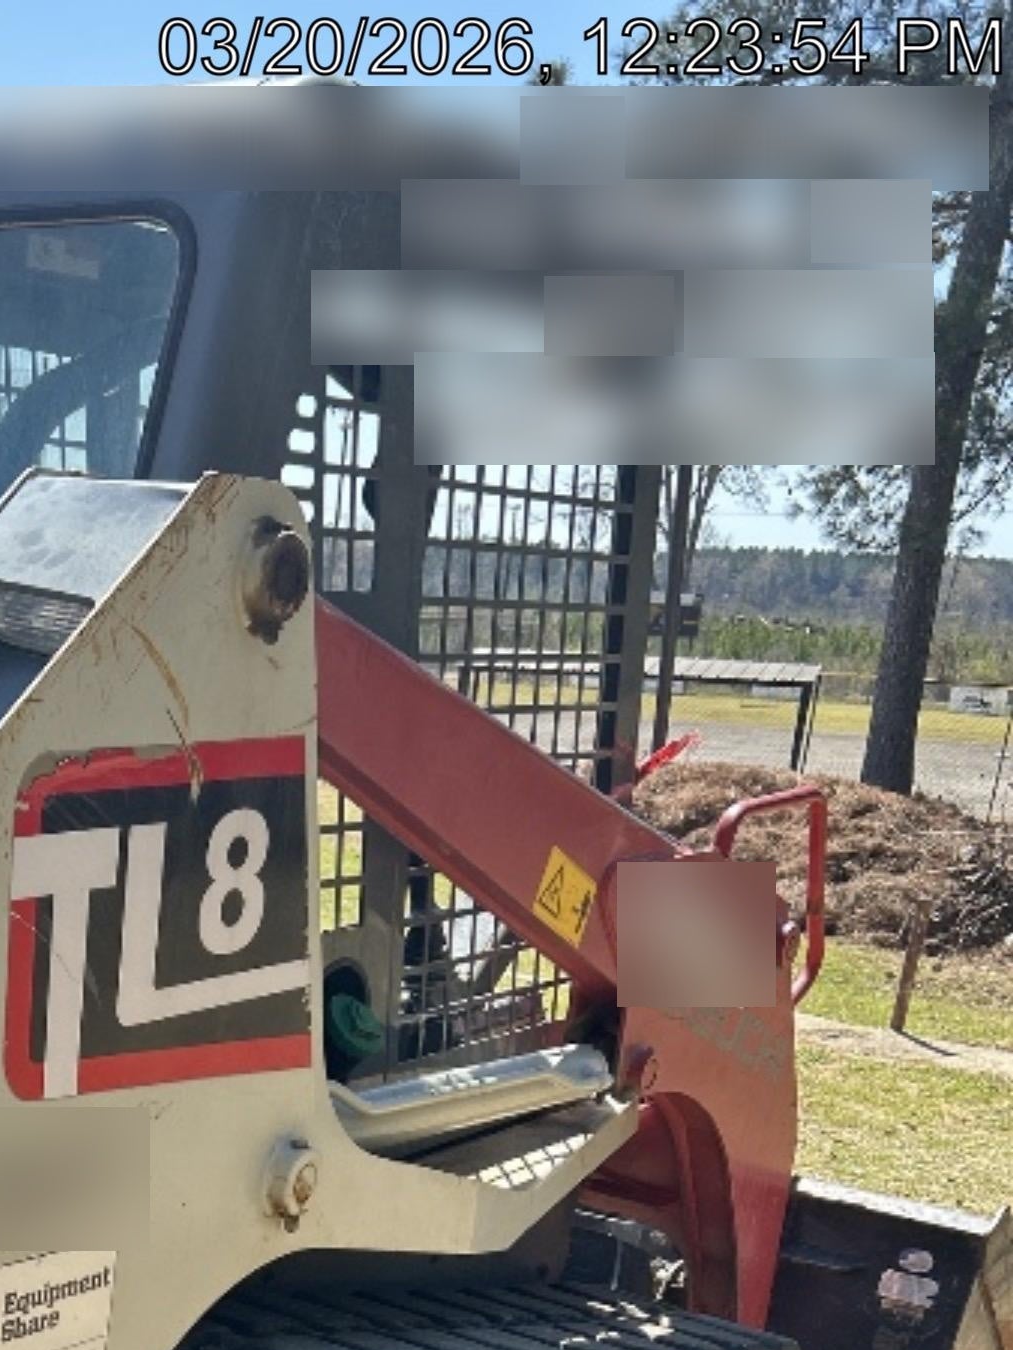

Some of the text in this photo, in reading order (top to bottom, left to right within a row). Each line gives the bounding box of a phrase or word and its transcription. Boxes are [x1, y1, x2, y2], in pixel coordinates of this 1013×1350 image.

[11, 807, 310, 1100] TL8
[3, 1265, 111, 1315] Equipment
[0, 1310, 61, 1344] Share
